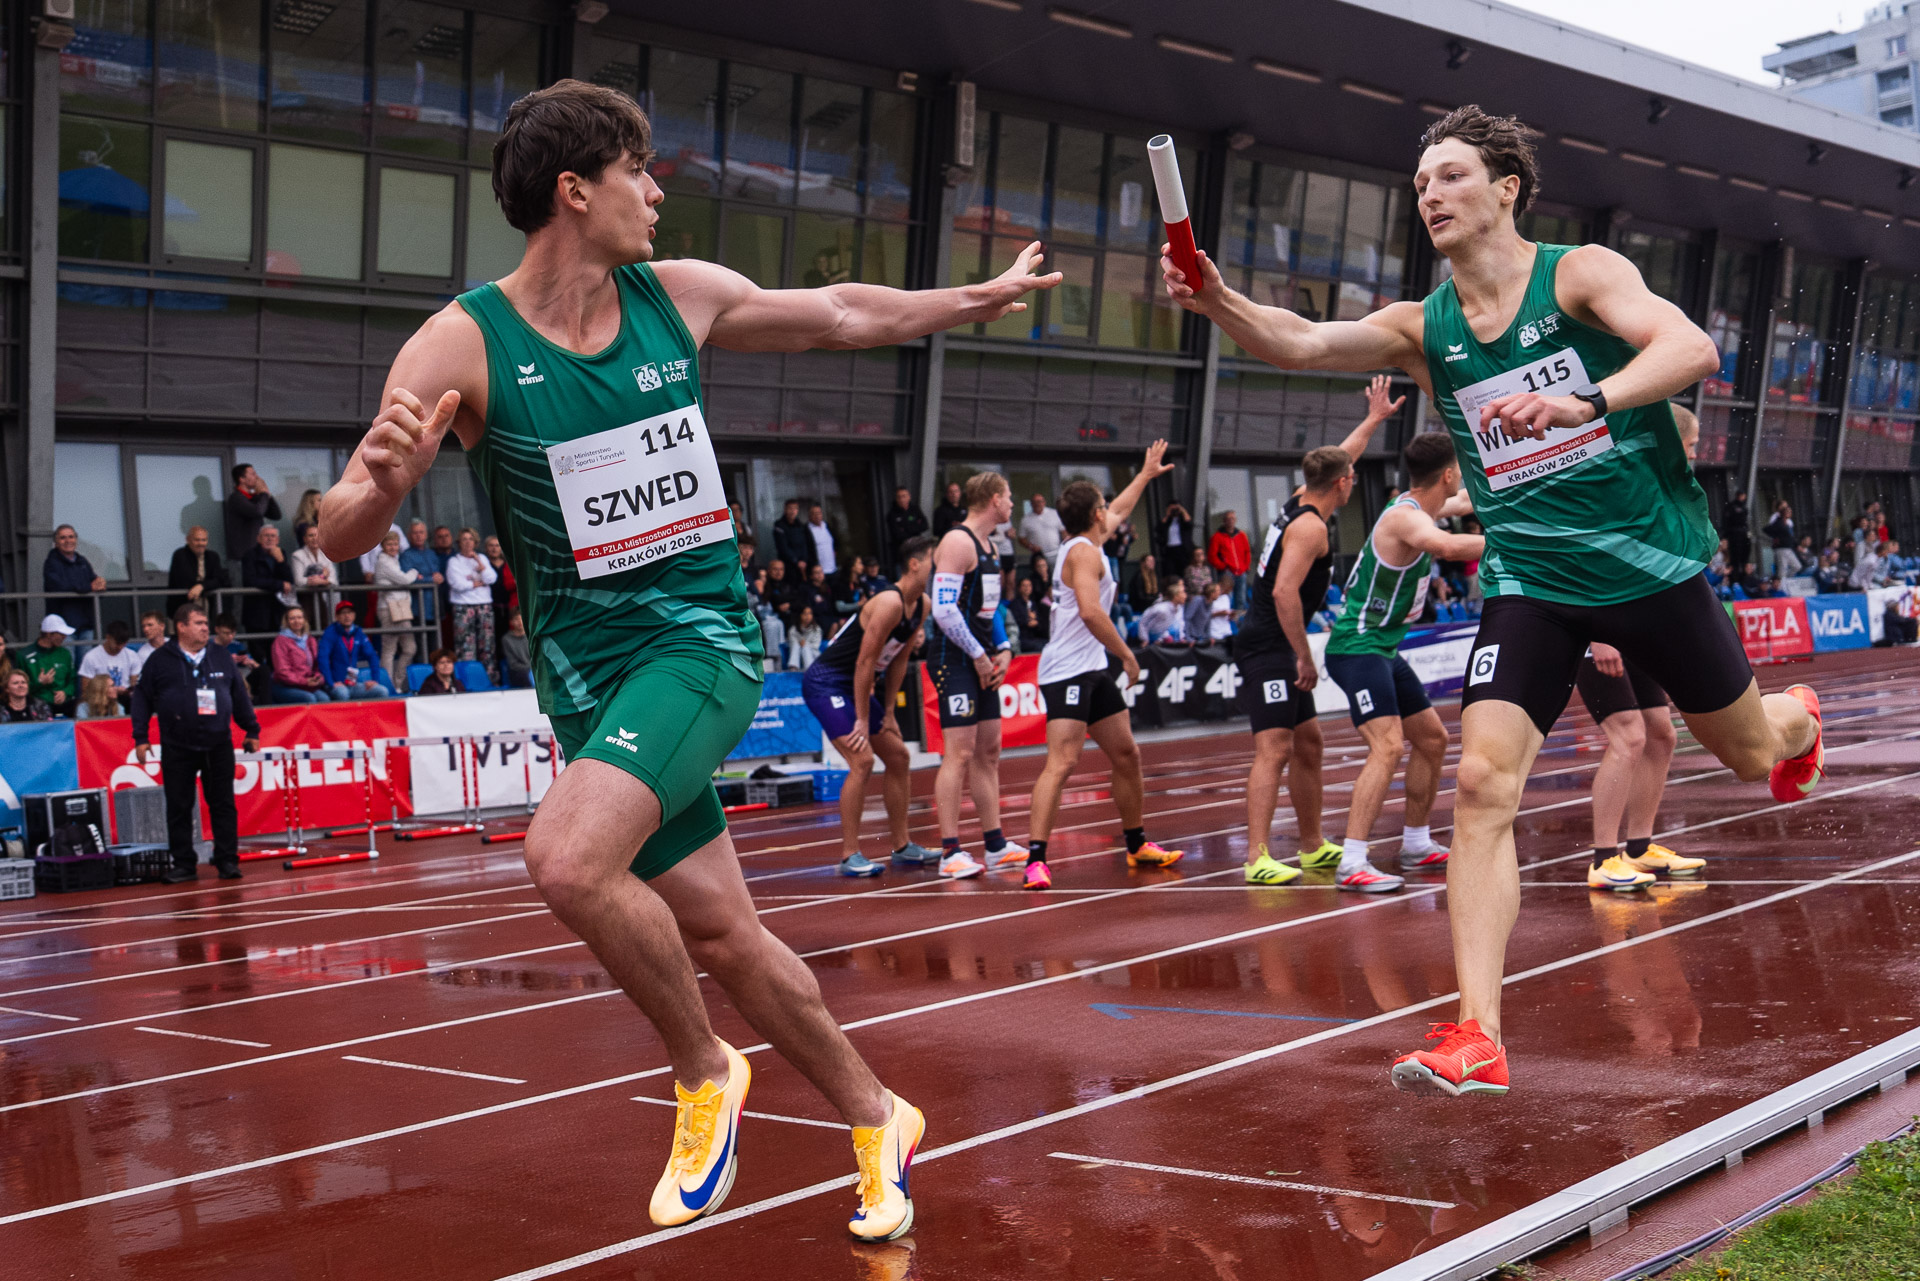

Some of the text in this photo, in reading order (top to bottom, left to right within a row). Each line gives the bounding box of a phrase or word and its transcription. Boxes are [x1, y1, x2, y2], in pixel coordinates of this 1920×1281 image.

[1445, 352, 1468, 362] erima
[518, 374, 545, 385] erima
[665, 371, 688, 383] ŁÓDŹ
[1522, 358, 1571, 393] 115
[639, 417, 695, 456] 114
[1517, 447, 1560, 466] Mistrzostwa
[1560, 438, 1582, 451] Polski
[1582, 431, 1597, 443] U23
[574, 447, 612, 459] Ministerstwo
[576, 457, 596, 467] Sportu
[599, 450, 625, 462] Turystyki
[1507, 449, 1588, 483] KRAKÓW 2026
[583, 470, 700, 527] SZWED
[588, 514, 715, 557] 43. PZLA Mistrzostwa Polski U23
[607, 532, 702, 571] KRAKÓW 2026
[1811, 607, 1866, 636] MZLA
[1474, 651, 1495, 677] 6
[1068, 688, 1078, 701] 5
[1157, 665, 1197, 704] 4F
[1270, 682, 1282, 699] 8
[953, 696, 966, 713] 2
[1360, 694, 1371, 708] 4
[605, 735, 639, 753] erima
[233, 738, 388, 796] ORLEN
